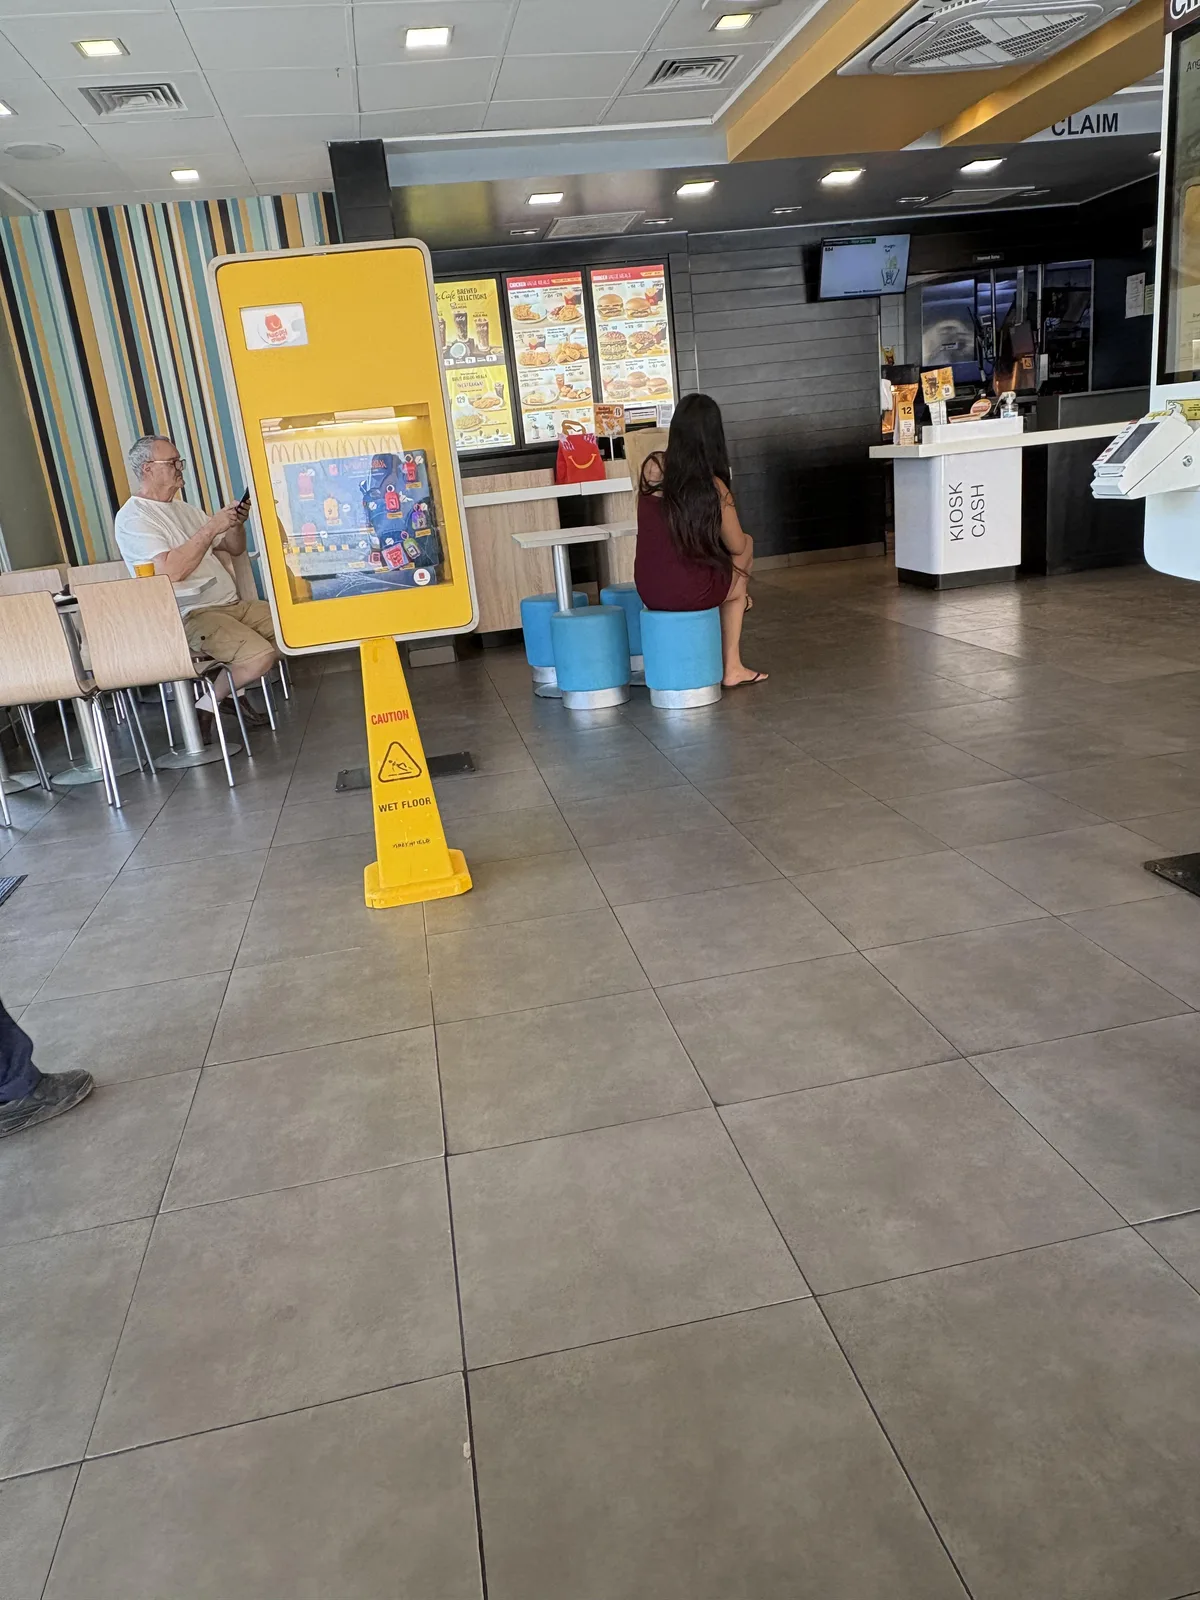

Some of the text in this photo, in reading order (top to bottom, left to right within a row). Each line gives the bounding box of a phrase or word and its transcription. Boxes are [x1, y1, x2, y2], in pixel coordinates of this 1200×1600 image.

[1051, 113, 1118, 136] CLAIM
[457, 287, 477, 295] BREWED
[457, 293, 487, 302] SELECTIONS
[901, 406, 912, 415] 12
[949, 482, 964, 541] KIOSK
[971, 484, 985, 537] CASH
[371, 709, 409, 725] CAUTION
[378, 797, 432, 813] WET FLOOR
